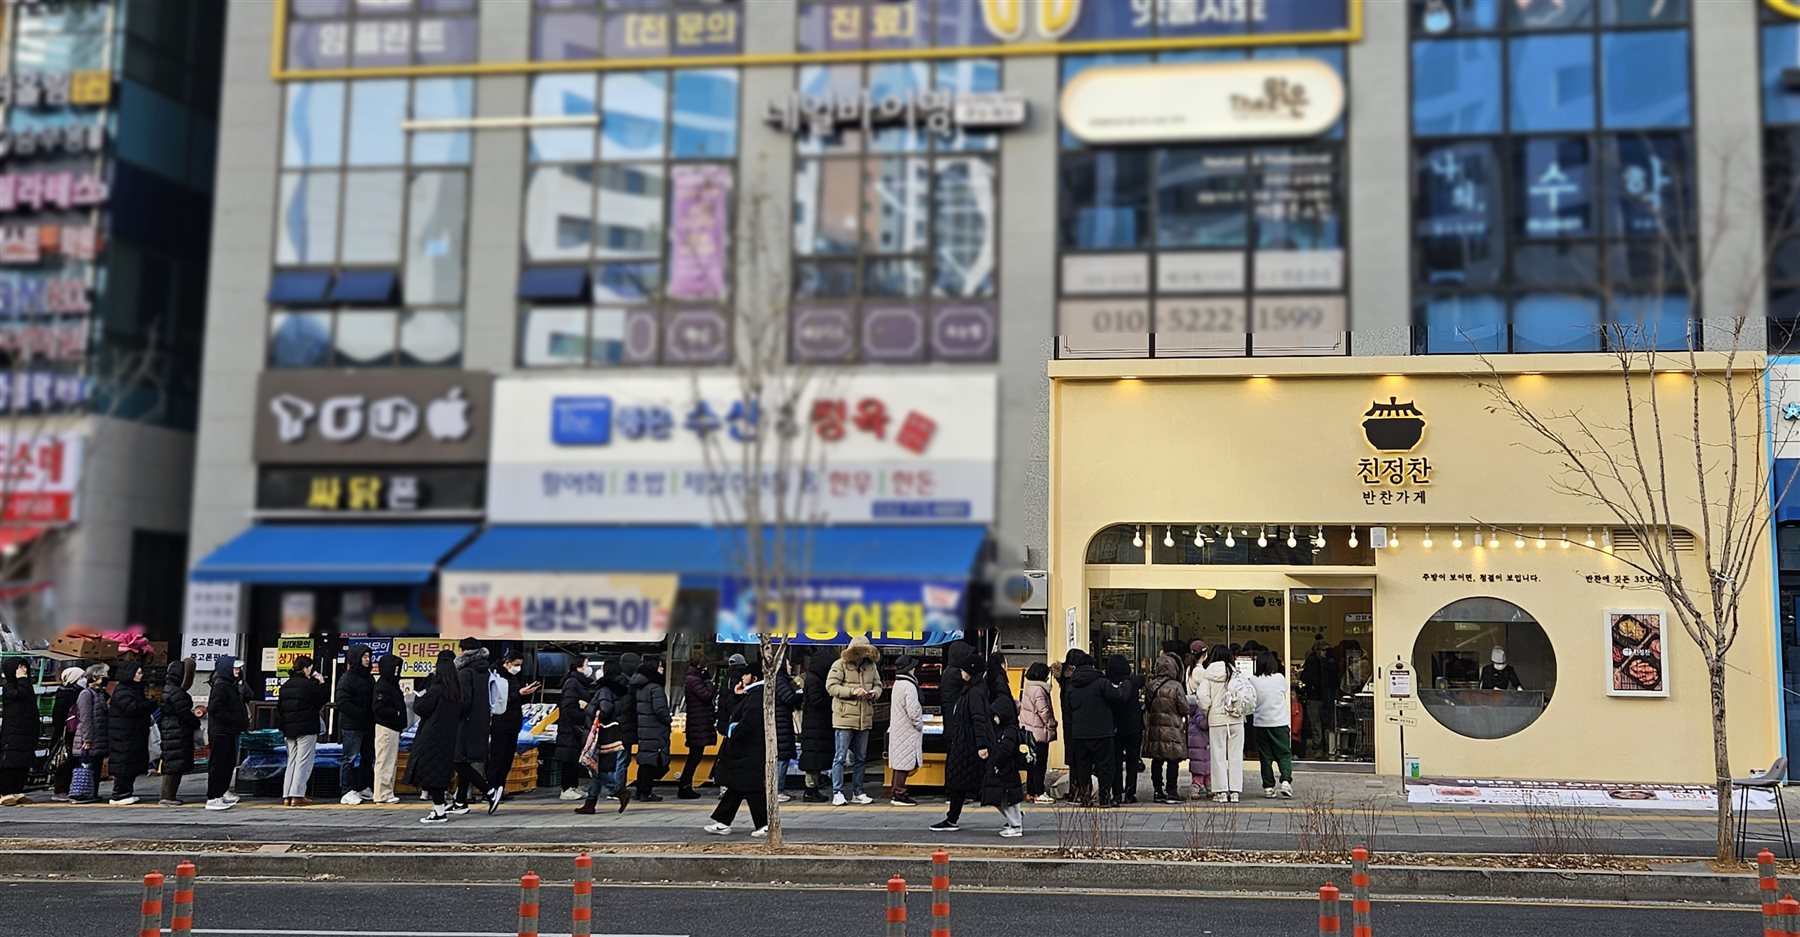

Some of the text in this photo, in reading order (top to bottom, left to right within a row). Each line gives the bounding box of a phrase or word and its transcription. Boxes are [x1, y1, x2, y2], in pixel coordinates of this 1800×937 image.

[1357, 457, 1432, 484] 친정찬
[1362, 490, 1426, 505] 반찬가게
[1422, 573, 1541, 583] 주방이 보이면, 청결이 보입니다.
[1586, 575, 1610, 584] 반찬에
[191, 637, 230, 648] 중고폰매입
[281, 640, 311, 649] 임대문의
